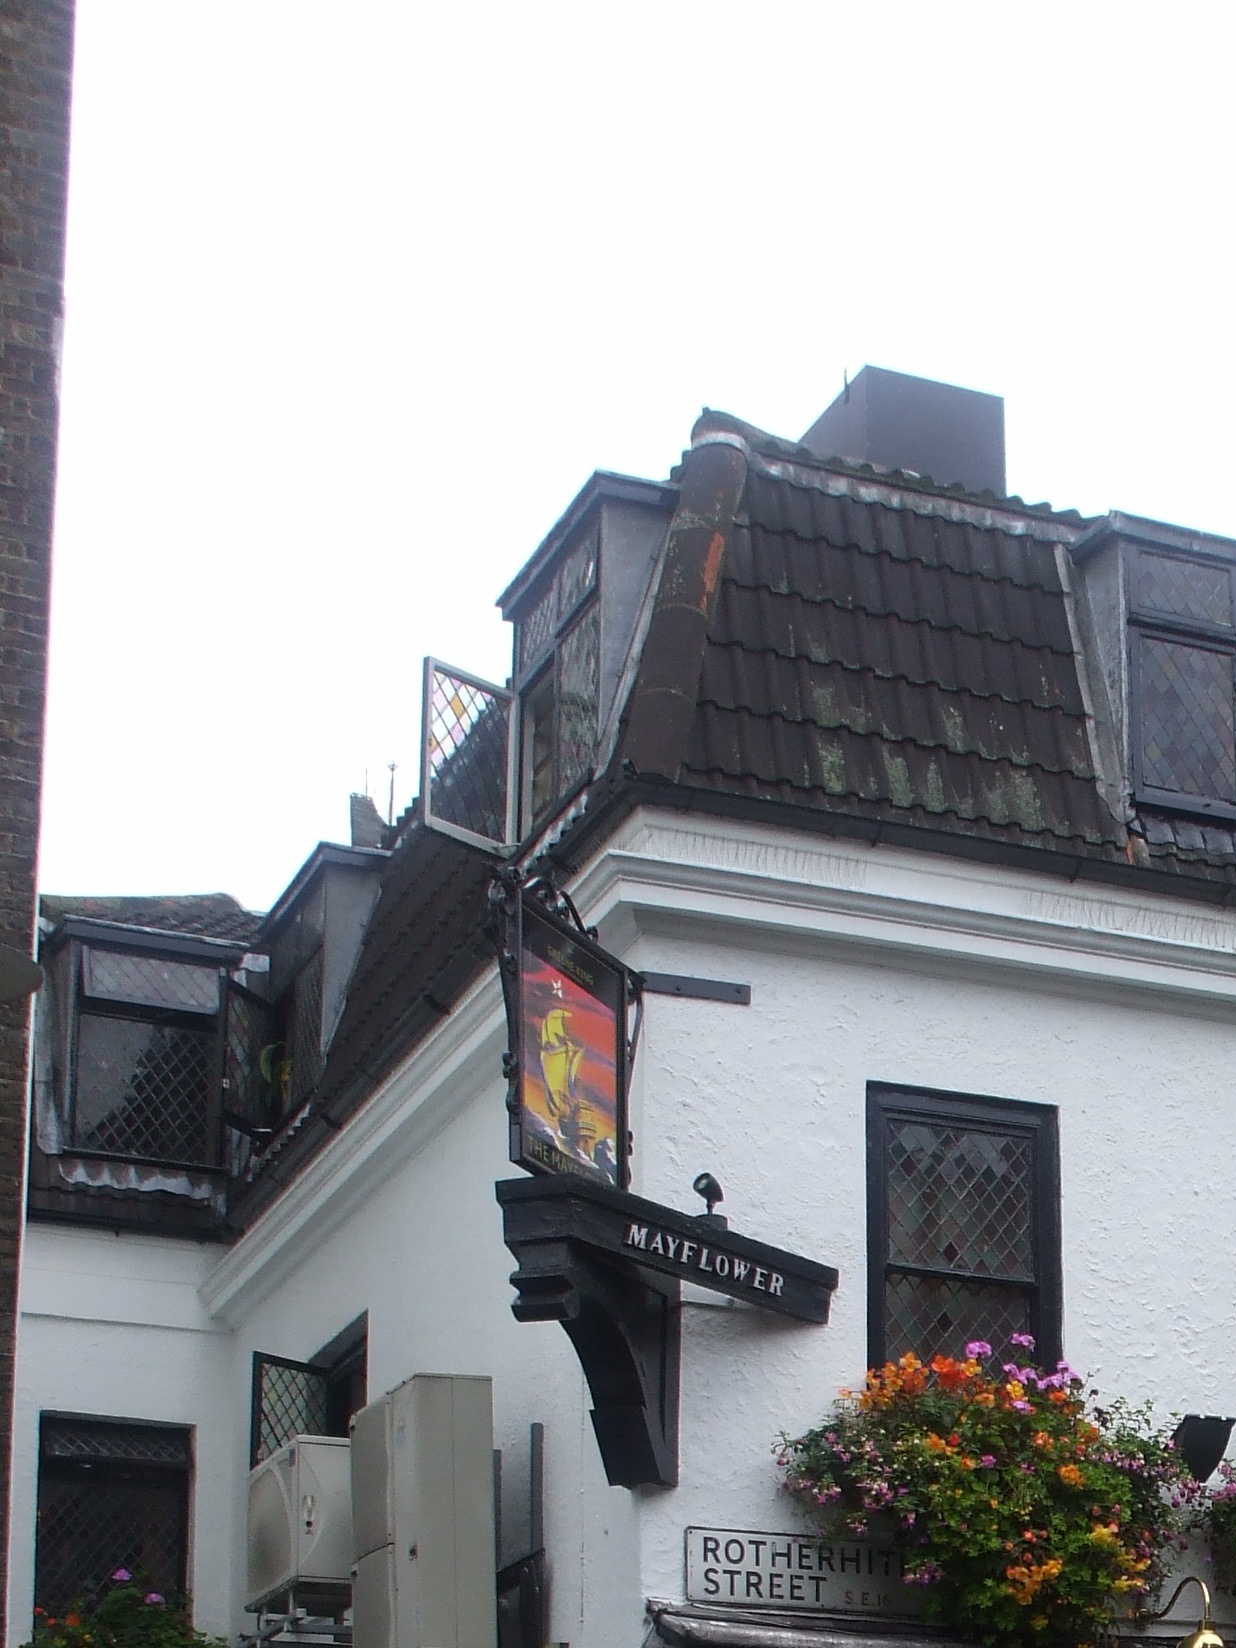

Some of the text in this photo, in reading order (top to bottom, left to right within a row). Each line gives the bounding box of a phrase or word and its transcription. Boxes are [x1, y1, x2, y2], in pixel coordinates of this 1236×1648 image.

[528, 1135, 549, 1163] THE
[626, 1223, 786, 1297] MAYFLOWER
[703, 1536, 905, 1577] ROTHERHIT
[703, 1567, 827, 1603] STREET
